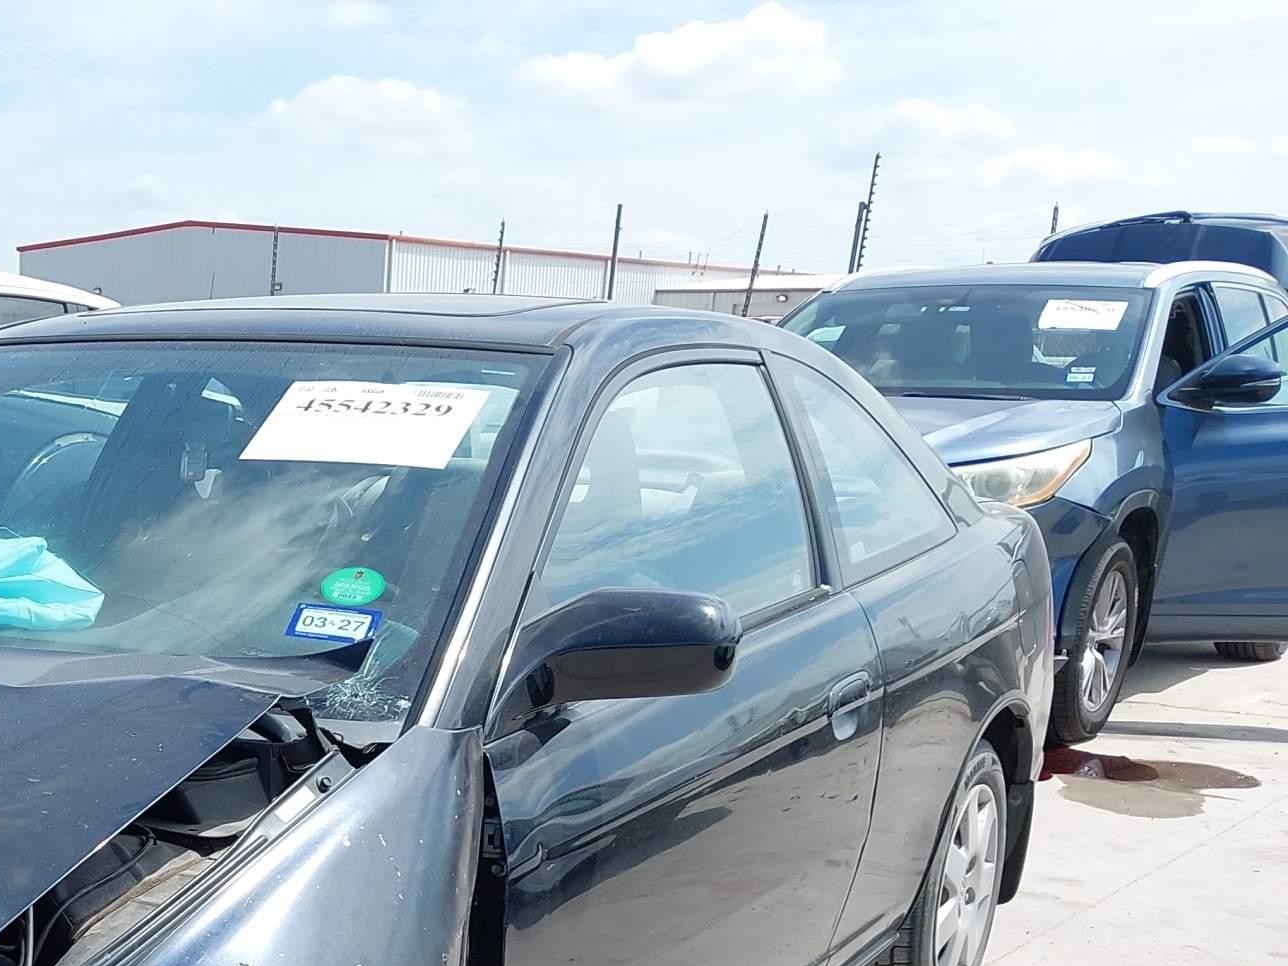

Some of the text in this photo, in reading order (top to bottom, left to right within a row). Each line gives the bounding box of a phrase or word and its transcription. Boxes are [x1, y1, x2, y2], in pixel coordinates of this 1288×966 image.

[296, 398, 454, 417] 45542329
[302, 615, 328, 628] 03
[337, 619, 365, 632] 27
